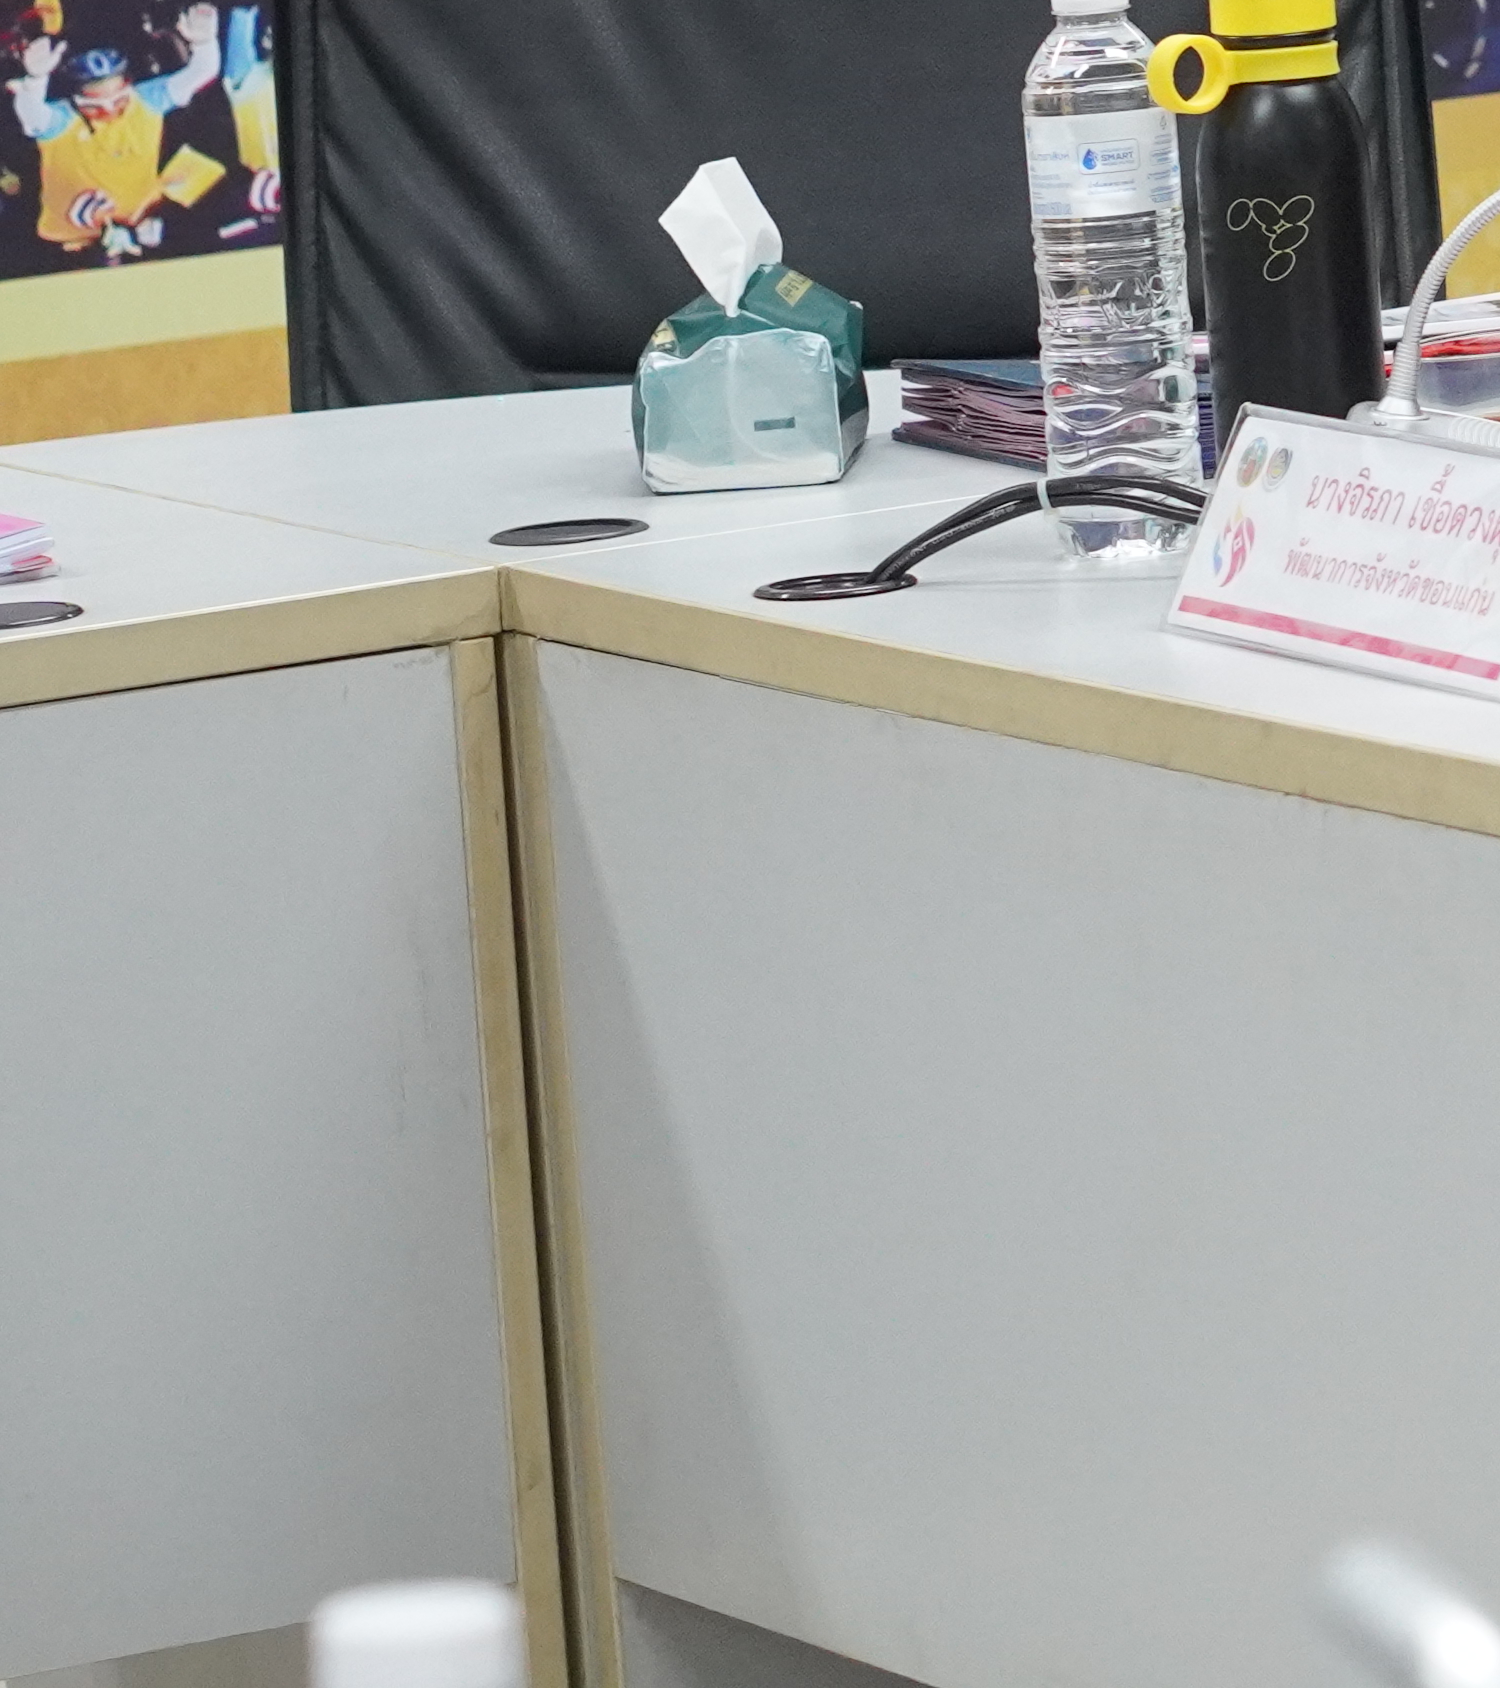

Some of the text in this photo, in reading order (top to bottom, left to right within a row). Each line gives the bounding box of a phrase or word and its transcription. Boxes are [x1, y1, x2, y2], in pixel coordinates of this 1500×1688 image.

[1101, 151, 1134, 162] SMART
[1305, 466, 1406, 526] นางจิรภา
[1283, 536, 1496, 616] พัฒนาการจังหวัดขอนแก่น
